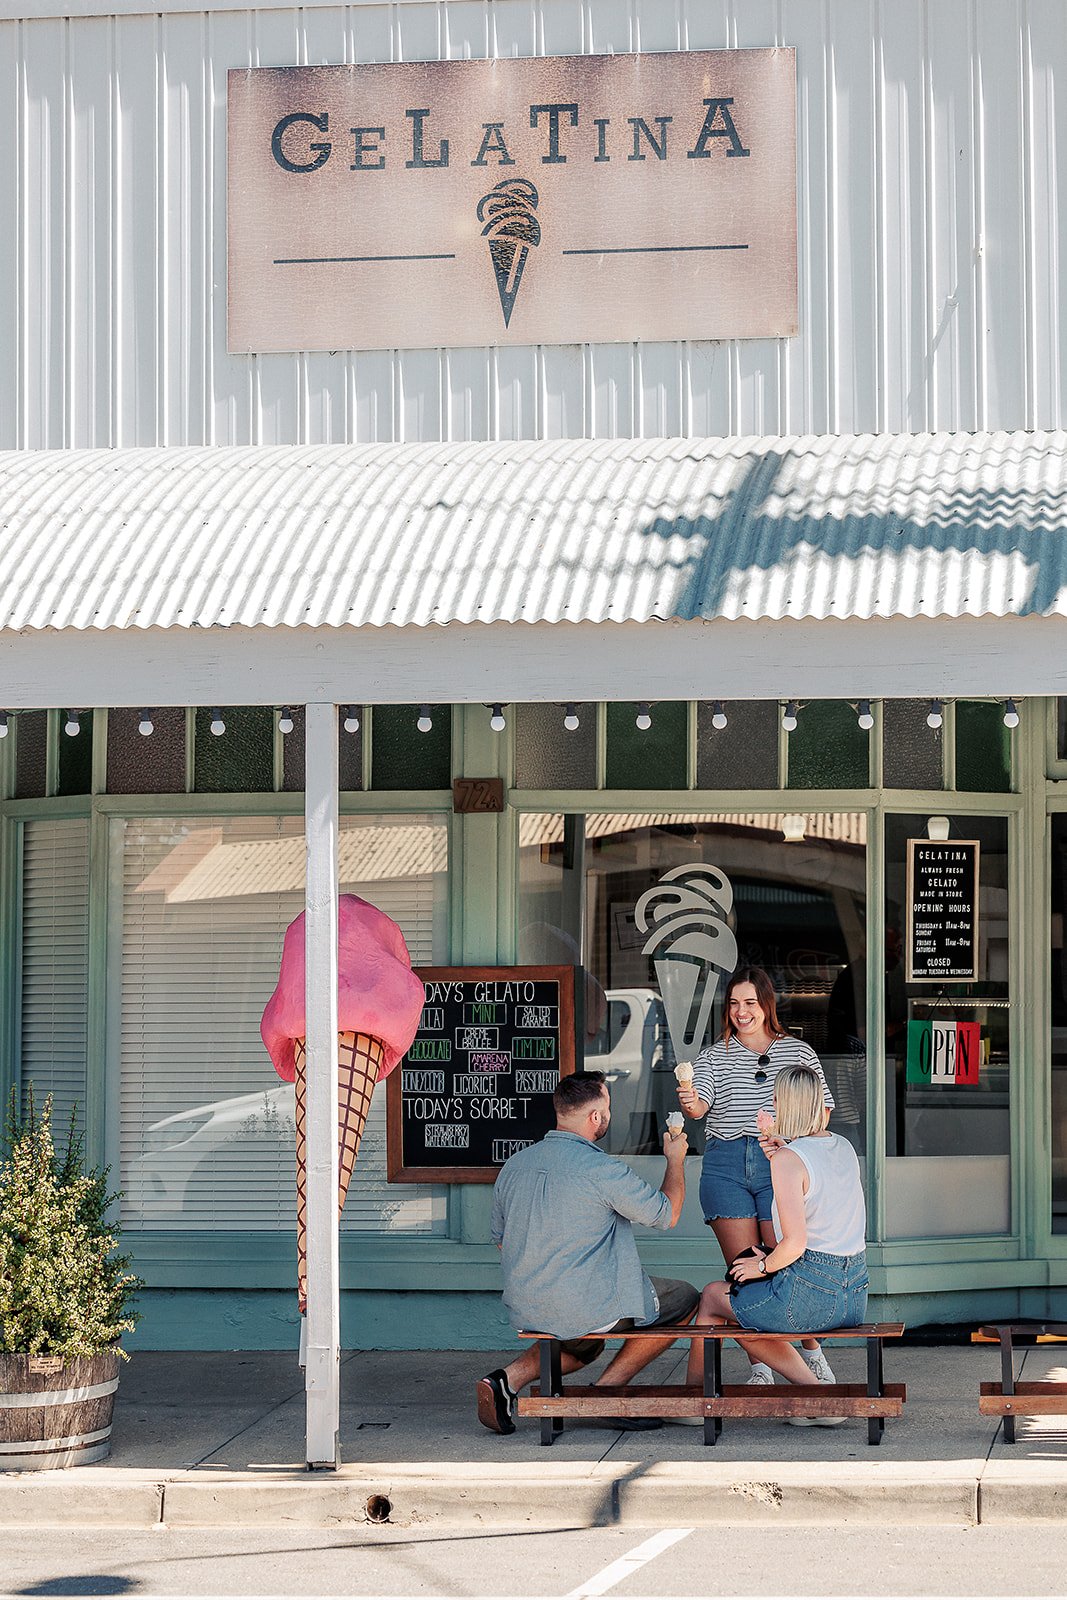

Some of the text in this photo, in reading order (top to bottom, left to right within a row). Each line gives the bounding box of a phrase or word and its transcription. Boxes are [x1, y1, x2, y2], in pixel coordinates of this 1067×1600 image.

[458, 781, 501, 810] 72A
[919, 851, 967, 860] GELATINA
[928, 878, 957, 887] GELATO
[920, 890, 935, 898] MADE
[946, 890, 963, 898] STORE
[914, 903, 971, 913] OPENING HOURS
[916, 922, 938, 930] THURSDAY
[927, 958, 951, 967] CLOSED
[424, 982, 535, 1002] DAY'S GELATO
[472, 1004, 497, 1024] MINT
[523, 1006, 550, 1017] SALTED
[522, 1016, 550, 1026] CARAMEL
[920, 1028, 970, 1076] OPEN
[472, 1054, 509, 1063] AMARENA
[474, 1062, 507, 1072] CHERRY
[456, 1075, 494, 1095] LICORICE
[403, 1098, 532, 1119] TODAY'S SORBET
[496, 1141, 532, 1161] LEMO
